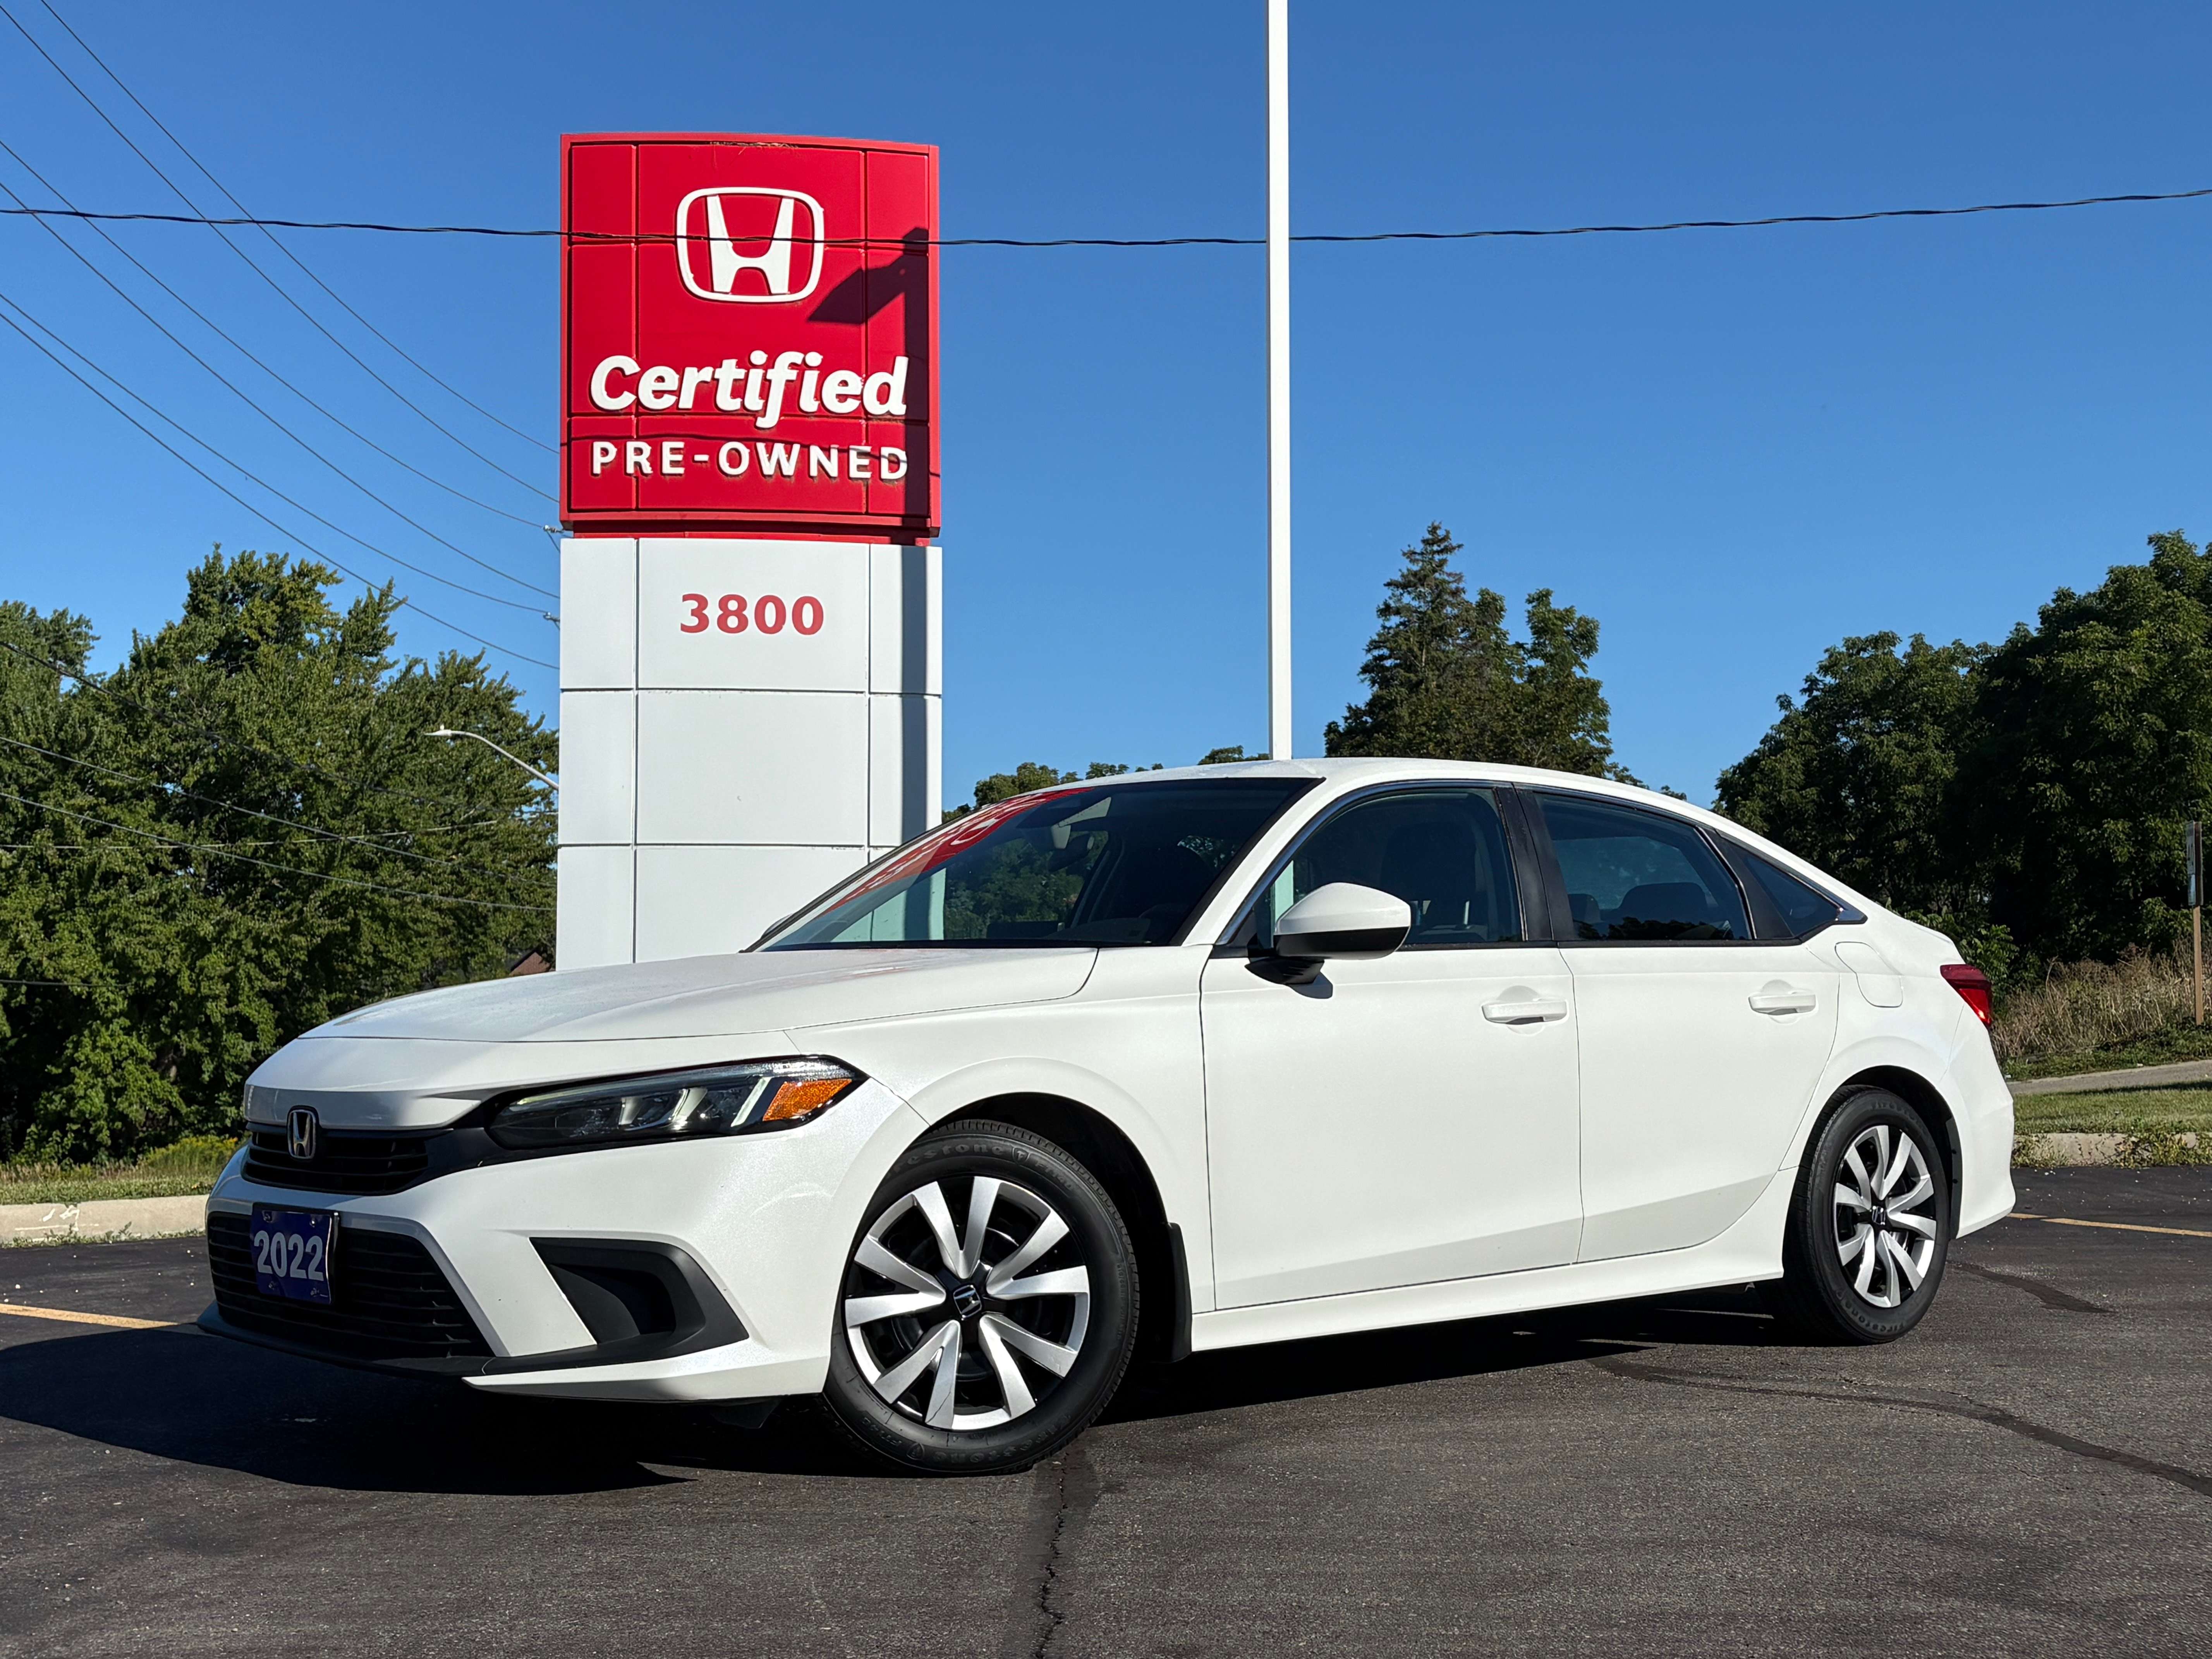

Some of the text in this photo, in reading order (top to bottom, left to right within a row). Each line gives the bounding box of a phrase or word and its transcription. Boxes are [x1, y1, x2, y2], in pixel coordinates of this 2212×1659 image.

[591, 350, 908, 428] Certified
[593, 441, 907, 479] PRE-OWNED
[680, 593, 824, 635] 3800
[254, 1230, 324, 1281] 2022
